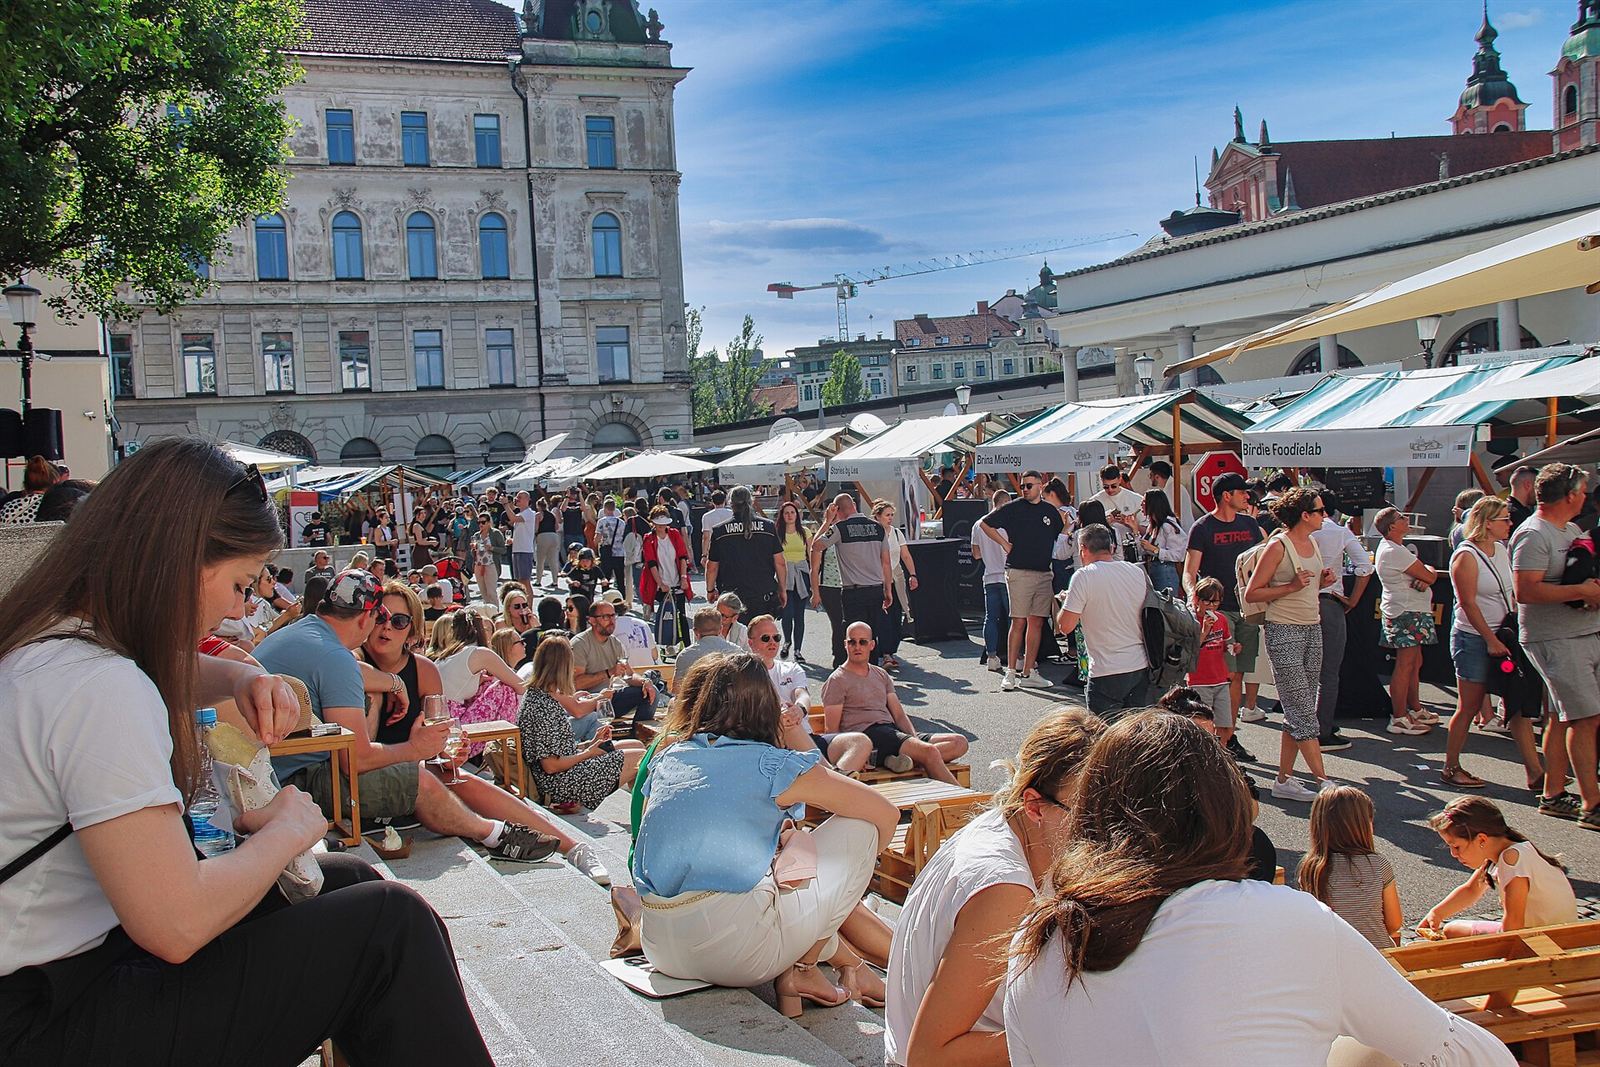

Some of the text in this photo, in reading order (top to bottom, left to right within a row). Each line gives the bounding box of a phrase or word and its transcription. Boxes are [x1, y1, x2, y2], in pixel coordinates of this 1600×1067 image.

[1243, 442, 1322, 456] Birdie Foodielab
[977, 454, 1022, 467] Brina Mixology
[830, 465, 845, 475] Stories
[724, 521, 764, 533] VARONJE
[1214, 531, 1253, 544] PETROL
